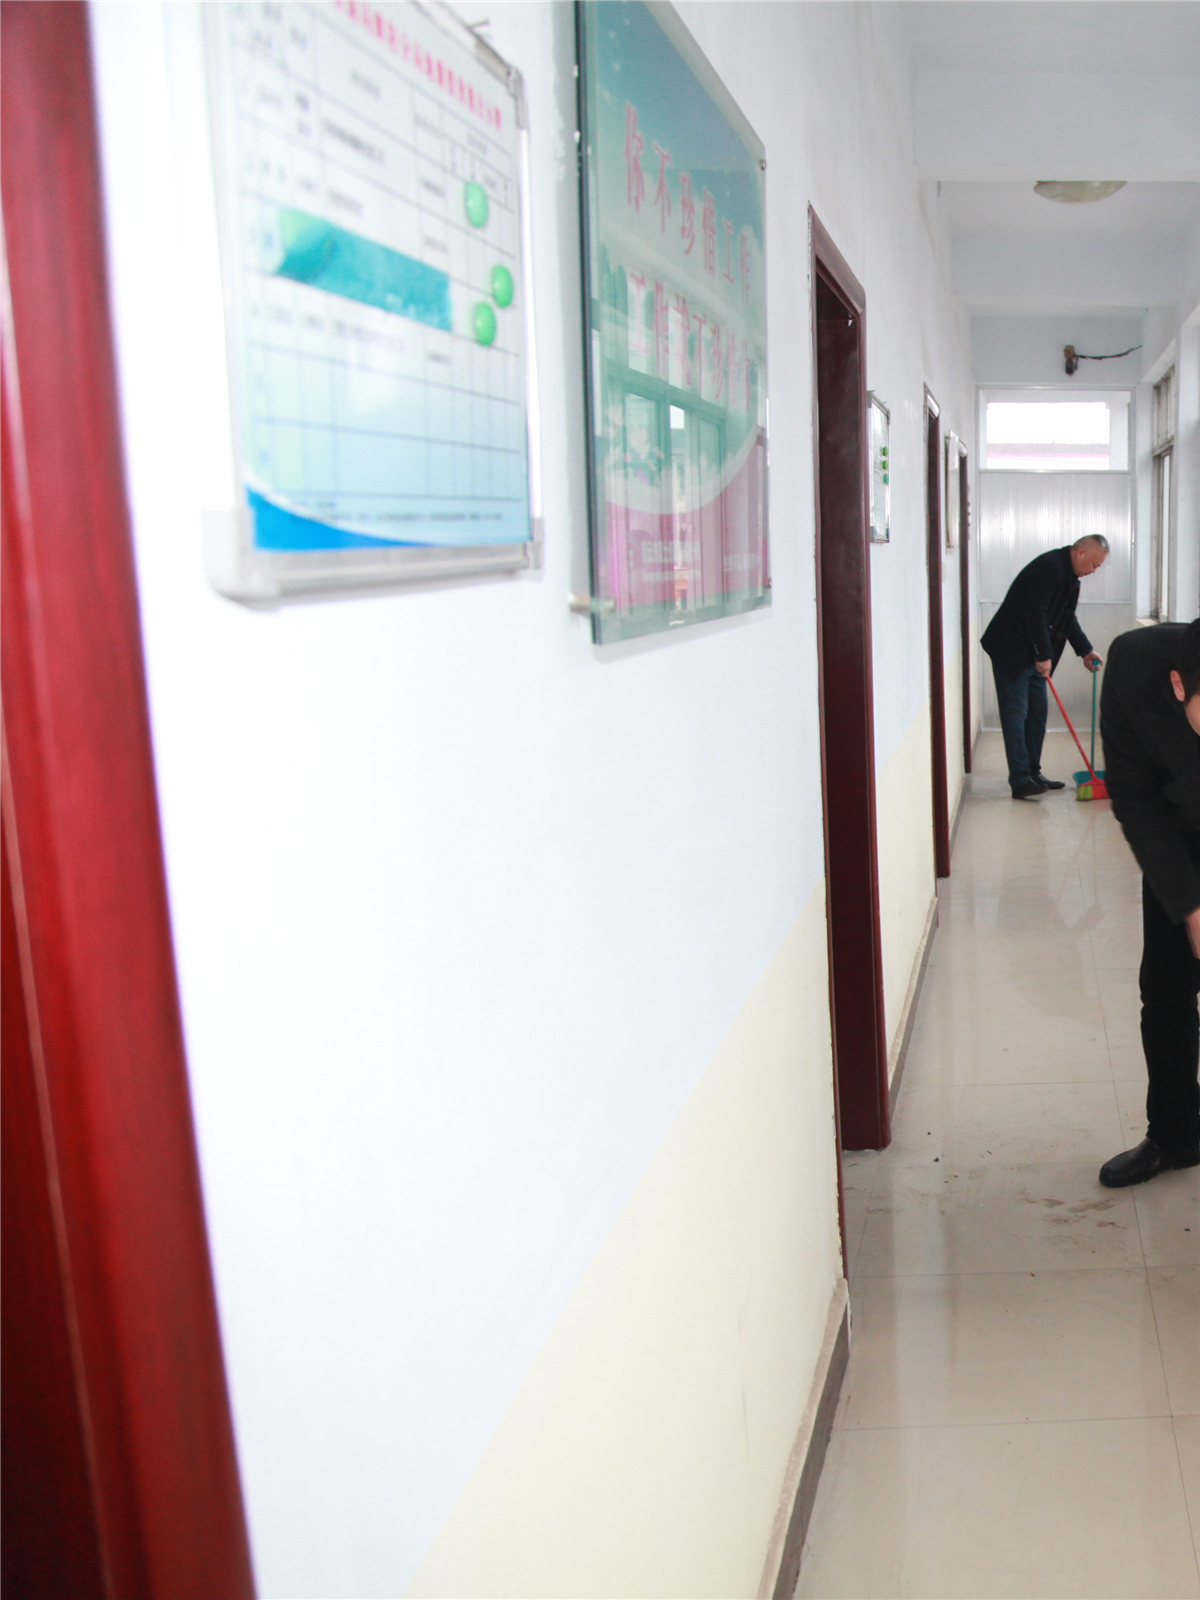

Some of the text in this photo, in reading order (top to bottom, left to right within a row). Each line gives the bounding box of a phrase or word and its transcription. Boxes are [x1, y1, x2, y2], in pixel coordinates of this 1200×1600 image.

[624, 100, 751, 306] 你不珍惜工作
